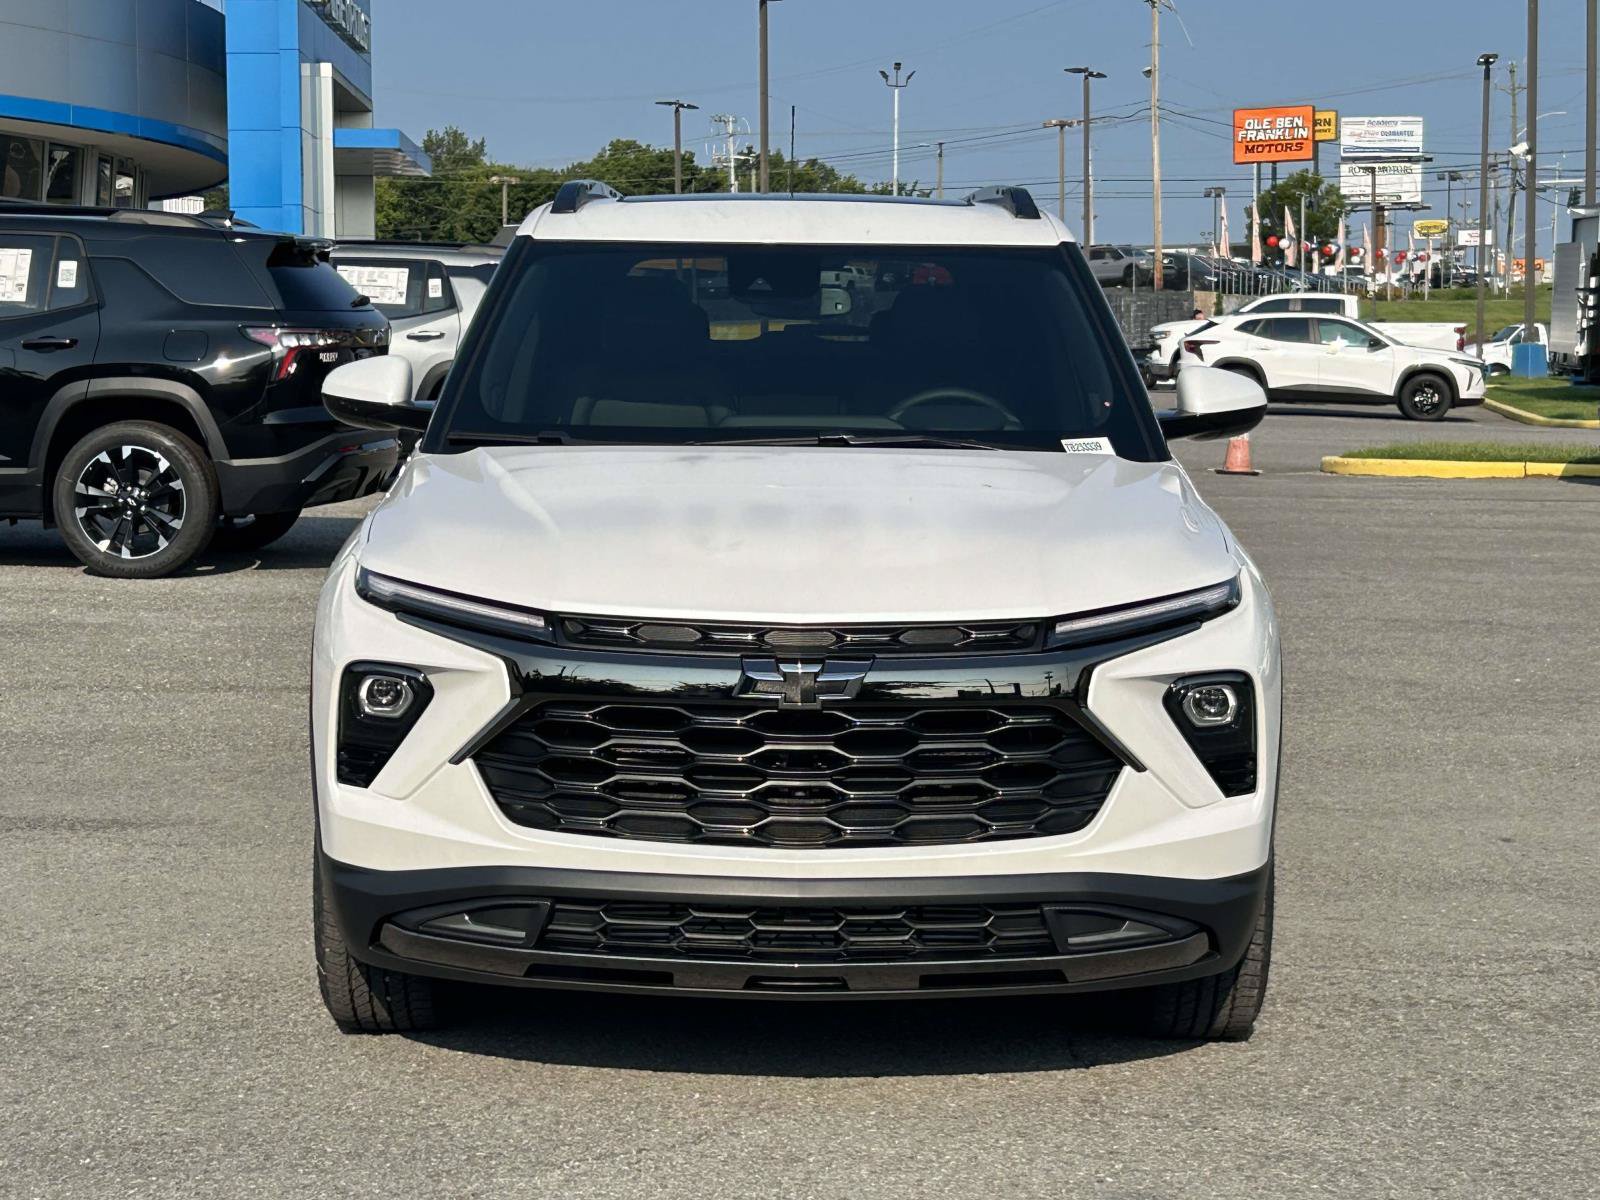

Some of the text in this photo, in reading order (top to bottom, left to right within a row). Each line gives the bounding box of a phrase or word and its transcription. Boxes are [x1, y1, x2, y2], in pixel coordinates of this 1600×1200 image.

[1245, 116, 1303, 130] OLE BEN
[1237, 127, 1309, 142] FRANKLIN
[1244, 142, 1305, 154] MOTORS
